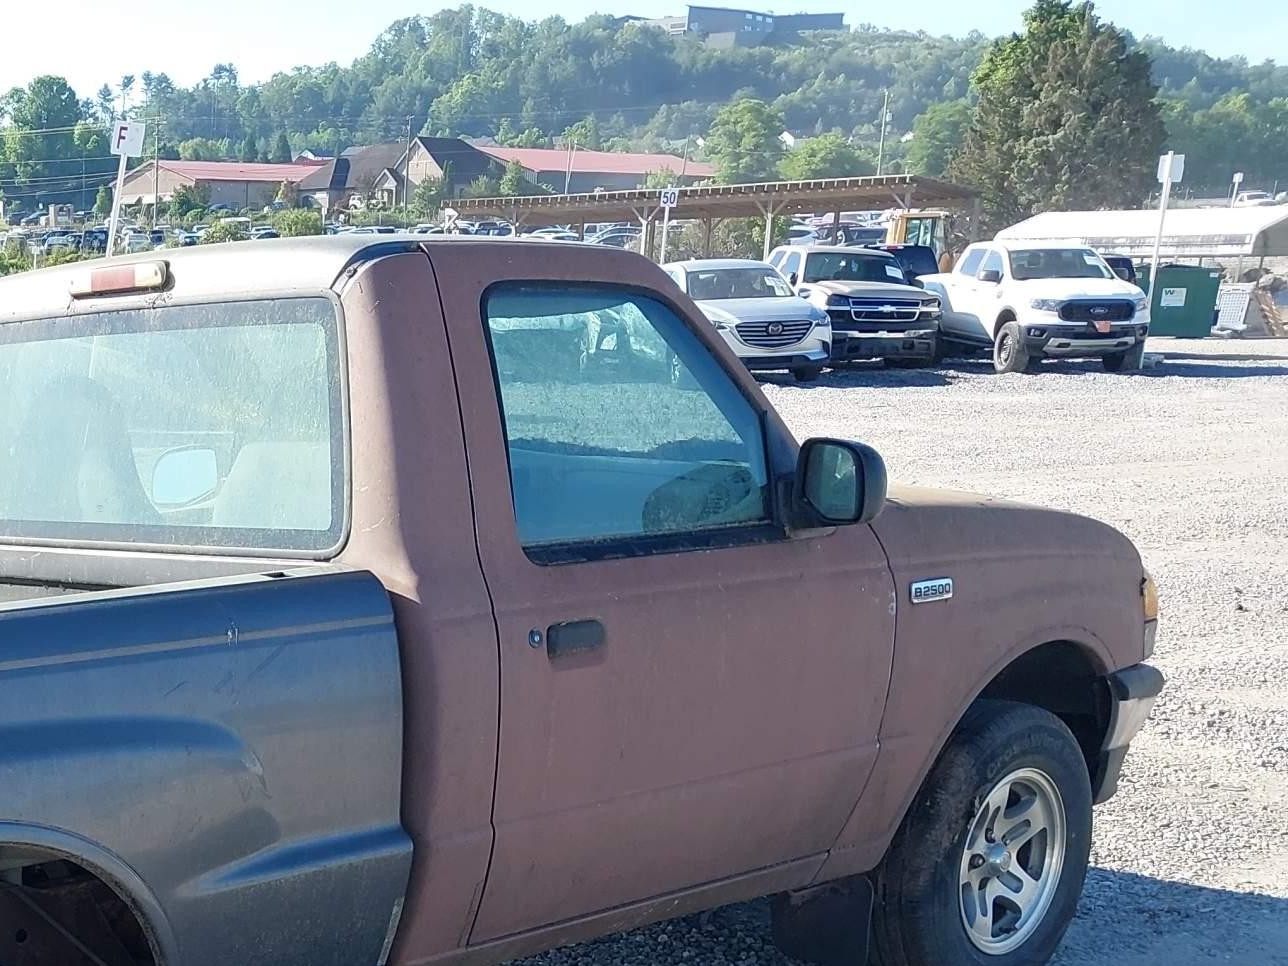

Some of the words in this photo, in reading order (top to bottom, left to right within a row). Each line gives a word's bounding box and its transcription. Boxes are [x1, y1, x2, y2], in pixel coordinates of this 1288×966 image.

[116, 126, 129, 149] F
[662, 191, 677, 205] 50
[914, 583, 951, 598] B2500
